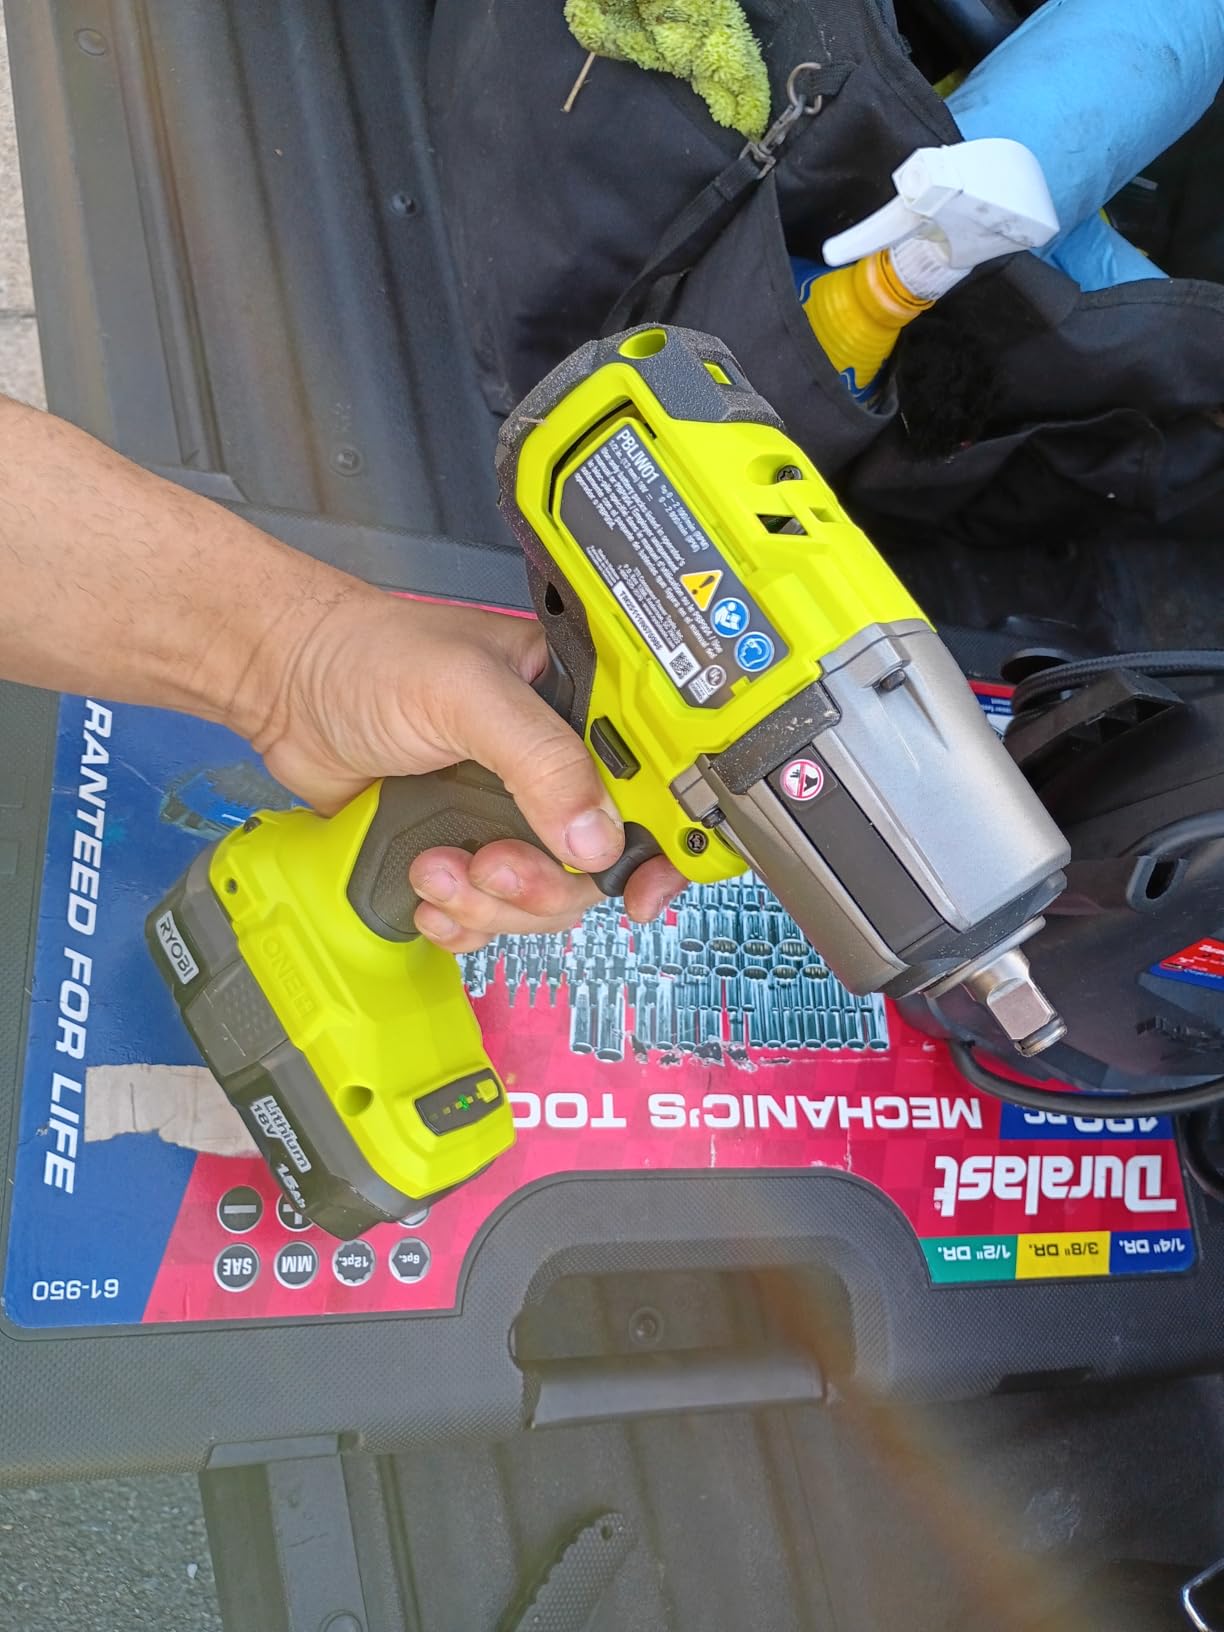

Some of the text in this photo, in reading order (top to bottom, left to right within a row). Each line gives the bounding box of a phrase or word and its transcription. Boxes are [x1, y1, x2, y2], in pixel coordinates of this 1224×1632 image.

[617, 430, 659, 483] PBLIW01
[617, 471, 635, 495] battery
[160, 916, 195, 978] RYOBI
[56, 947, 93, 1060] FOR
[253, 1103, 279, 1136] 18V
[647, 1093, 984, 1130] MECHANIC'S
[44, 1072, 82, 1195] LIFE
[263, 1098, 309, 1169] Lithium
[933, 1155, 1178, 1217] Duralast
[398, 1252, 420, 1265] 6pt.
[937, 1244, 1012, 1261] 1/2" DR.
[1029, 1242, 1099, 1257] 3/8" DR.
[1118, 1239, 1150, 1254] DR.
[222, 1257, 253, 1276] SAE
[281, 1255, 313, 1273] MM
[338, 1256, 369, 1269] 12pt.
[32, 1278, 120, 1301] 61-950
